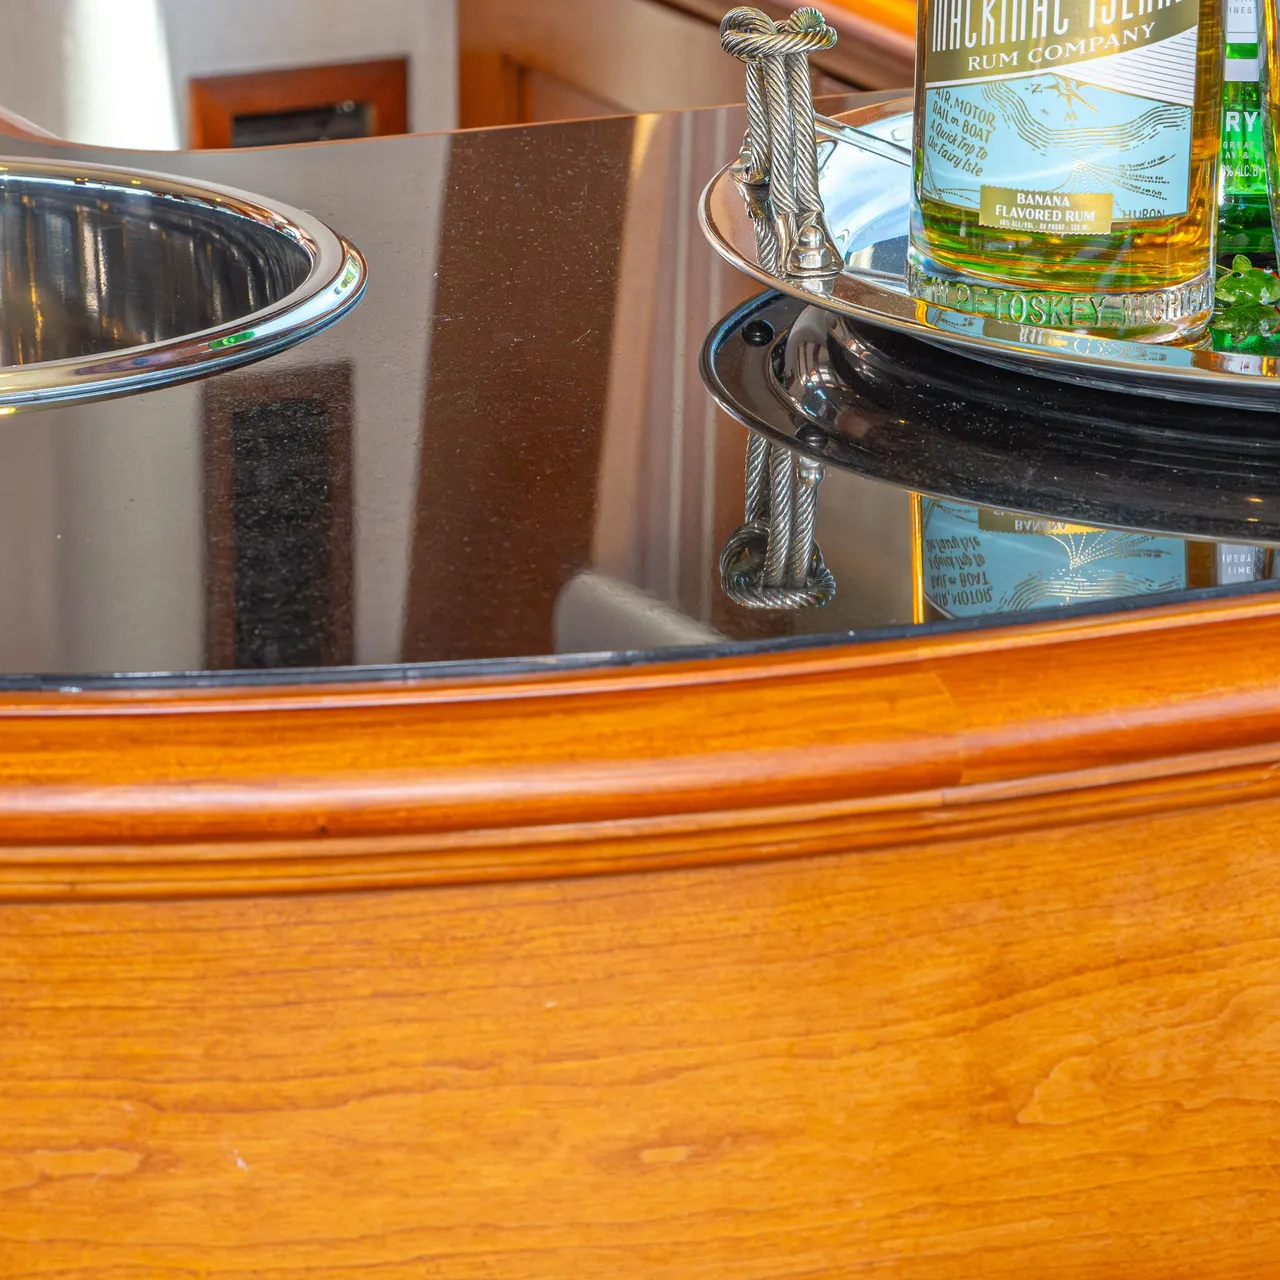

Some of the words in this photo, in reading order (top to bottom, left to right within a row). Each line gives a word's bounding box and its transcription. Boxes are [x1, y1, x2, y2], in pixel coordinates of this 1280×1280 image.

[968, 51, 1018, 71] RUM
[1028, 22, 1156, 64] COMPANY
[932, 101, 950, 124] RAIL
[961, 120, 993, 144] BOAT
[954, 98, 997, 131] MOTOR,
[929, 119, 935, 132] A
[935, 123, 958, 146] Quick
[957, 136, 976, 156] Trip
[976, 146, 988, 160] to
[937, 143, 963, 169] Fairy
[962, 158, 984, 177] Isle
[995, 204, 1062, 221] FLAVORED
[1065, 210, 1095, 222] RUM
[1016, 192, 1070, 207] BANANA
